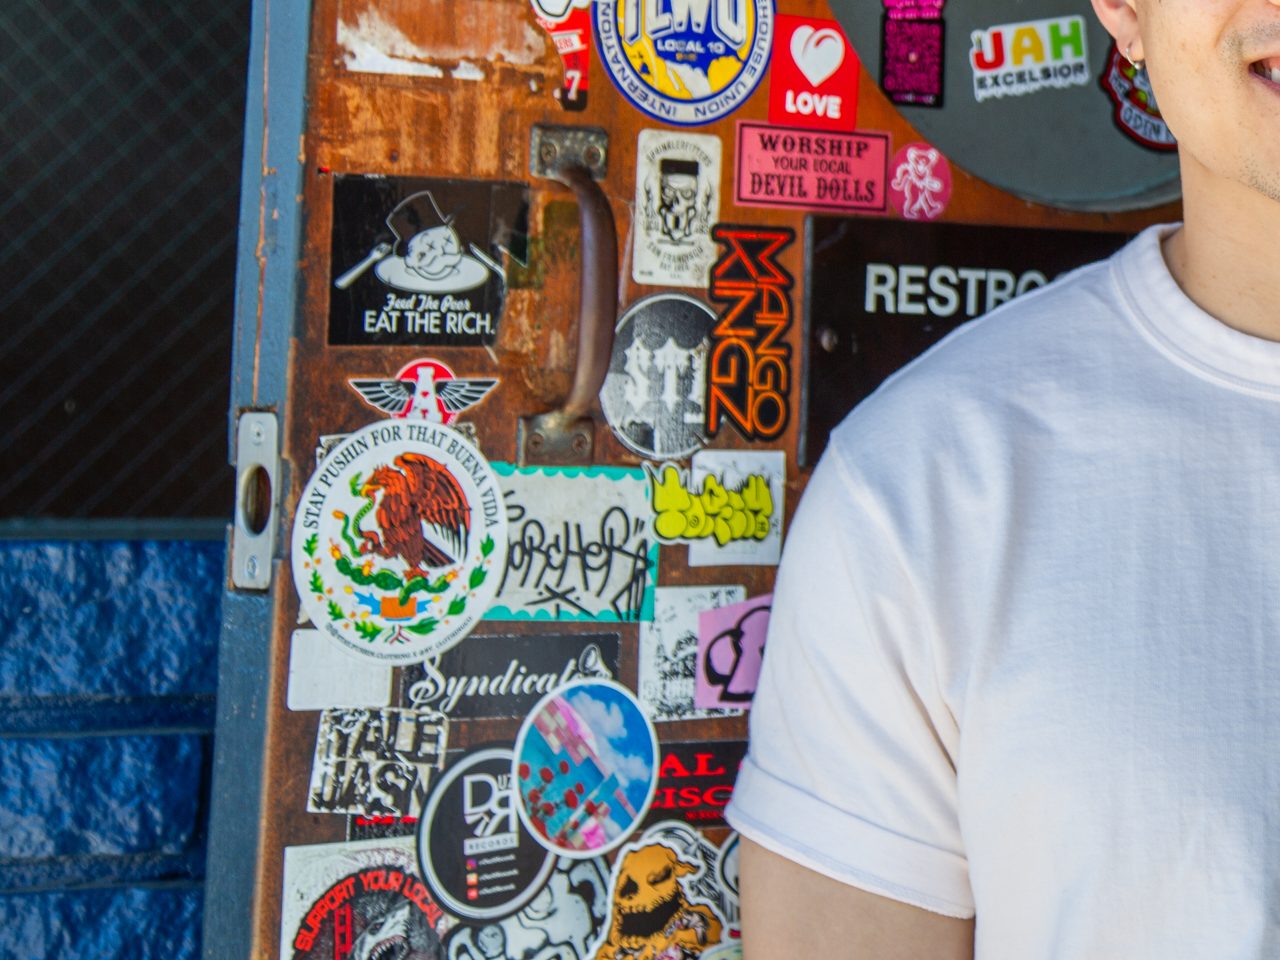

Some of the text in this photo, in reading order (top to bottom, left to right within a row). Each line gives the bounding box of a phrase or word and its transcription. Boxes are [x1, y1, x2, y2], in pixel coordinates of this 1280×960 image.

[599, 1, 748, 118] INTERNATION UNION
[656, 39, 726, 54] LOCAL 10
[972, 19, 1085, 71] JAH
[565, 69, 582, 101] 7
[976, 62, 1086, 90] EXCELSIOR
[784, 89, 843, 120] LOVE
[758, 132, 870, 176] WORSHIP YOUR LOCAL
[749, 171, 876, 204] DEVIL DOLLS
[363, 310, 496, 335] EAT THE RICH.
[302, 423, 501, 530] STAY PUSHIN FOR THAT BUENA VIDA
[408, 654, 577, 716] Syndicat
[468, 837, 515, 851] RECORDS
[294, 869, 444, 952] SUPPORT YOUR LOCAL
